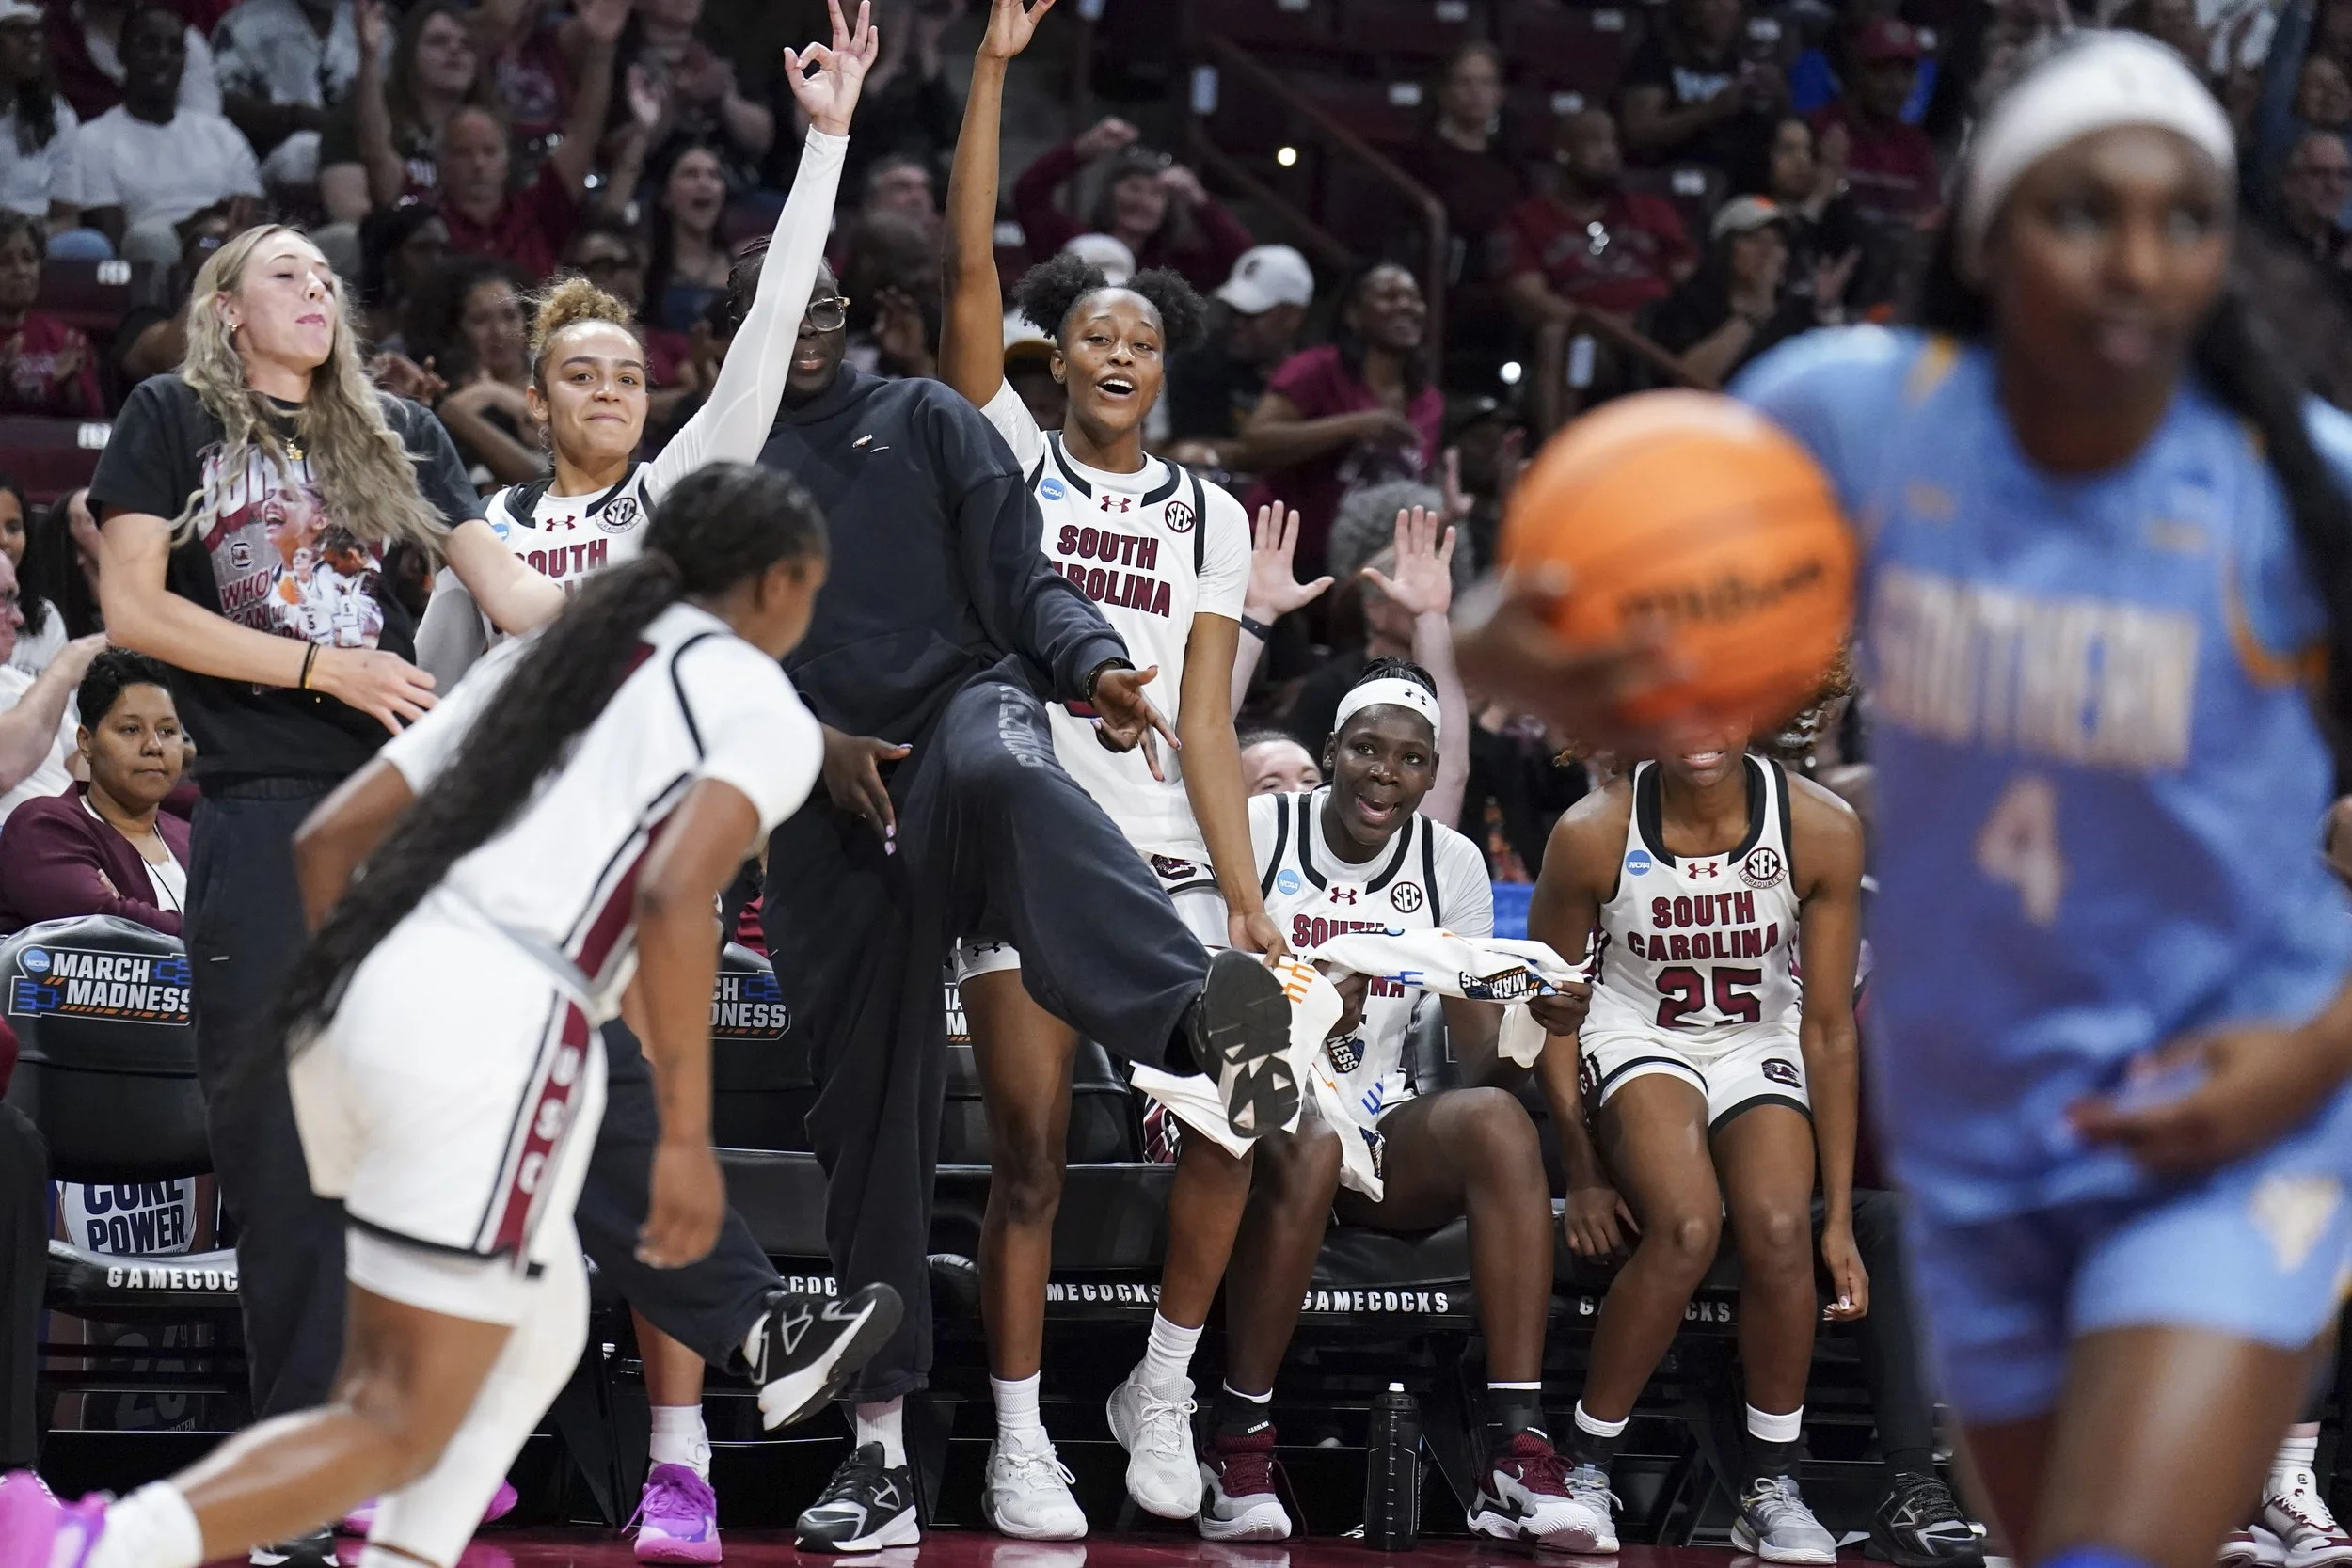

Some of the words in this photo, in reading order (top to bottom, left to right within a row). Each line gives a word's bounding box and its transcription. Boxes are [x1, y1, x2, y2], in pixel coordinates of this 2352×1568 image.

[1042, 486, 1063, 499] NCAA
[606, 499, 636, 524] SEC
[1167, 505, 1194, 531] SEC
[1057, 524, 1159, 570] SOUTH
[222, 569, 271, 613] WHO
[1052, 561, 1171, 618] ROLINA
[1629, 861, 1650, 869] NCAA
[1748, 849, 1778, 879] SEC
[1979, 777, 2065, 927] 4
[1744, 875, 1781, 888] GRADUATE
[1393, 884, 1421, 911] SEC
[1651, 890, 1756, 929] SOUTH
[1292, 913, 1385, 949] SOU
[1627, 922, 1779, 962] CAROLINA
[52, 952, 151, 983] MARCH
[1655, 966, 1762, 1027] 25
[709, 1002, 787, 1028] DNESS
[1327, 1035, 1359, 1072] NESS
[86, 1203, 186, 1254] POWER
[106, 1267, 238, 1292] GAMECOC
[1046, 1283, 1162, 1303] MECOCKS
[1301, 1291, 1449, 1313] GAMECOCKS
